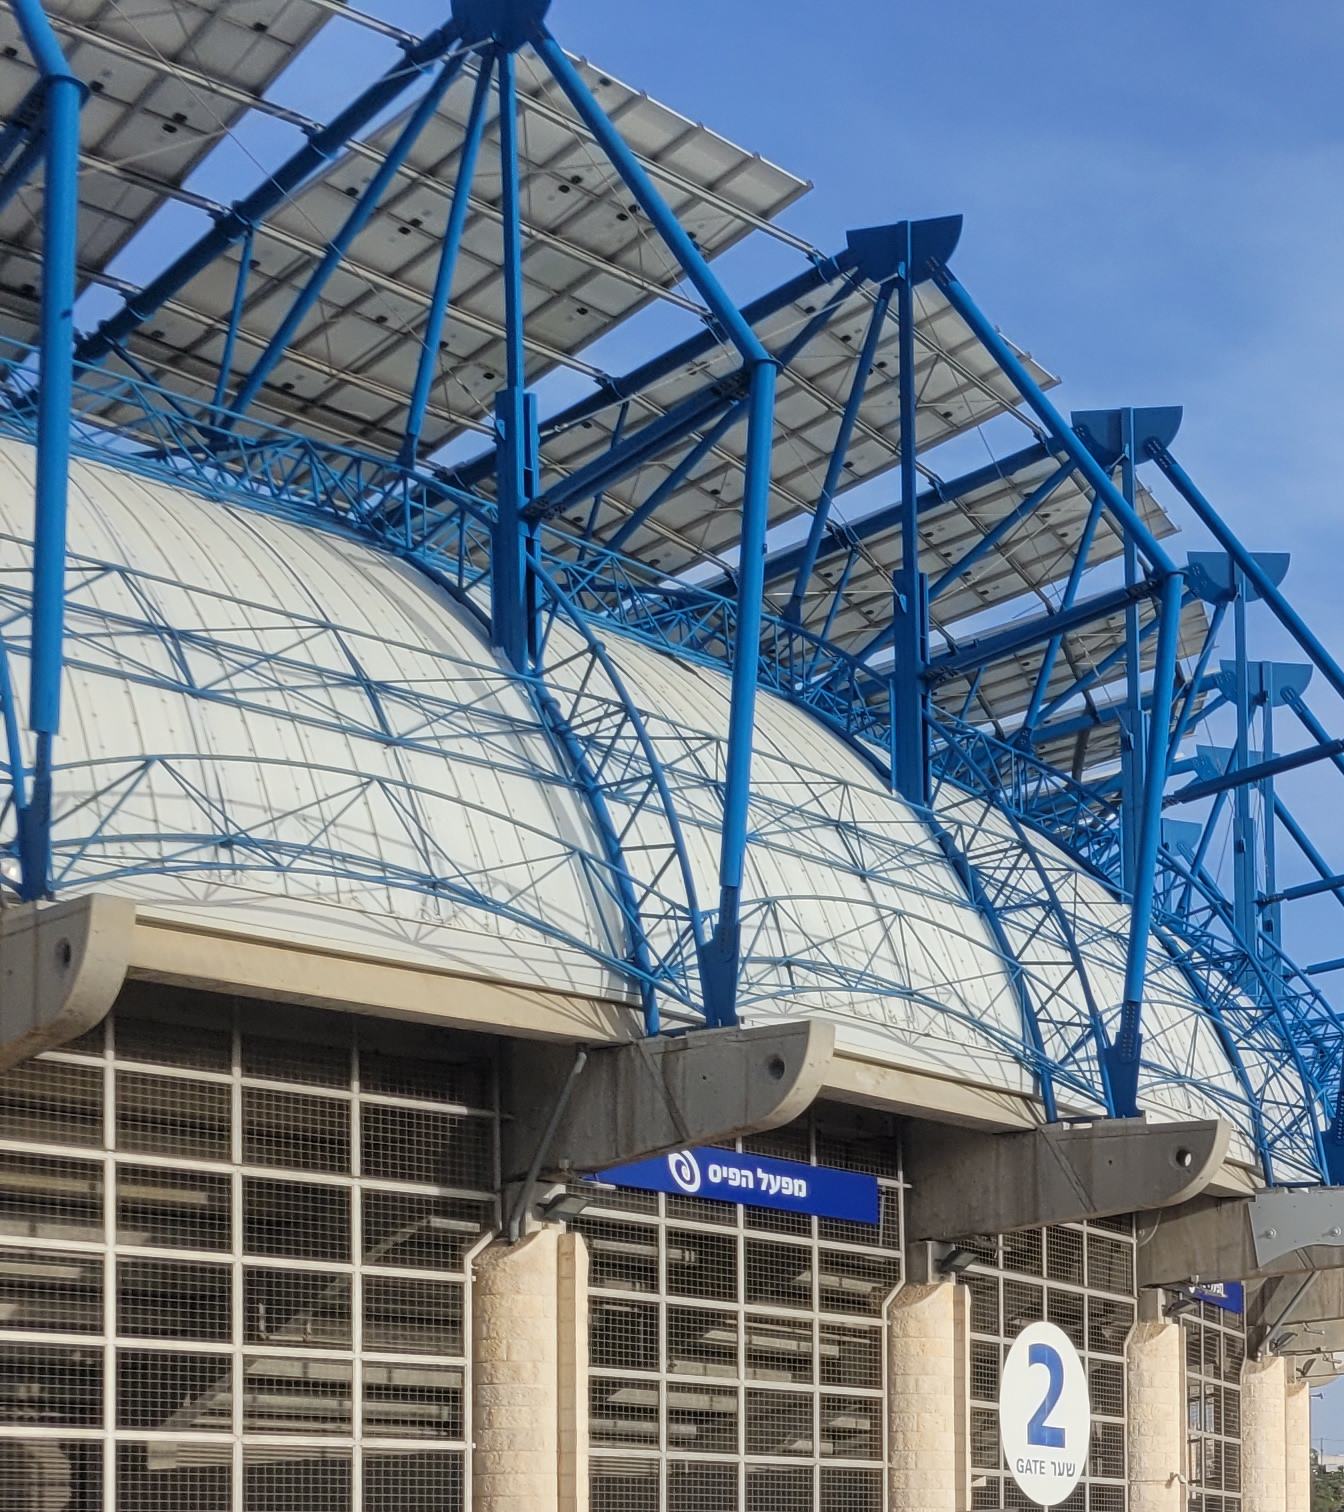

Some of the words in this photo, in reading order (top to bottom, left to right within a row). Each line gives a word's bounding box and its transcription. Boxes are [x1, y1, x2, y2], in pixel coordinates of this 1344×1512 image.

[708, 1164, 754, 1188] הפיס
[757, 1168, 807, 1198] מפעל
[1027, 1343, 1066, 1449] 2
[1016, 1458, 1046, 1475] GATE
[1050, 1461, 1076, 1477] שער
